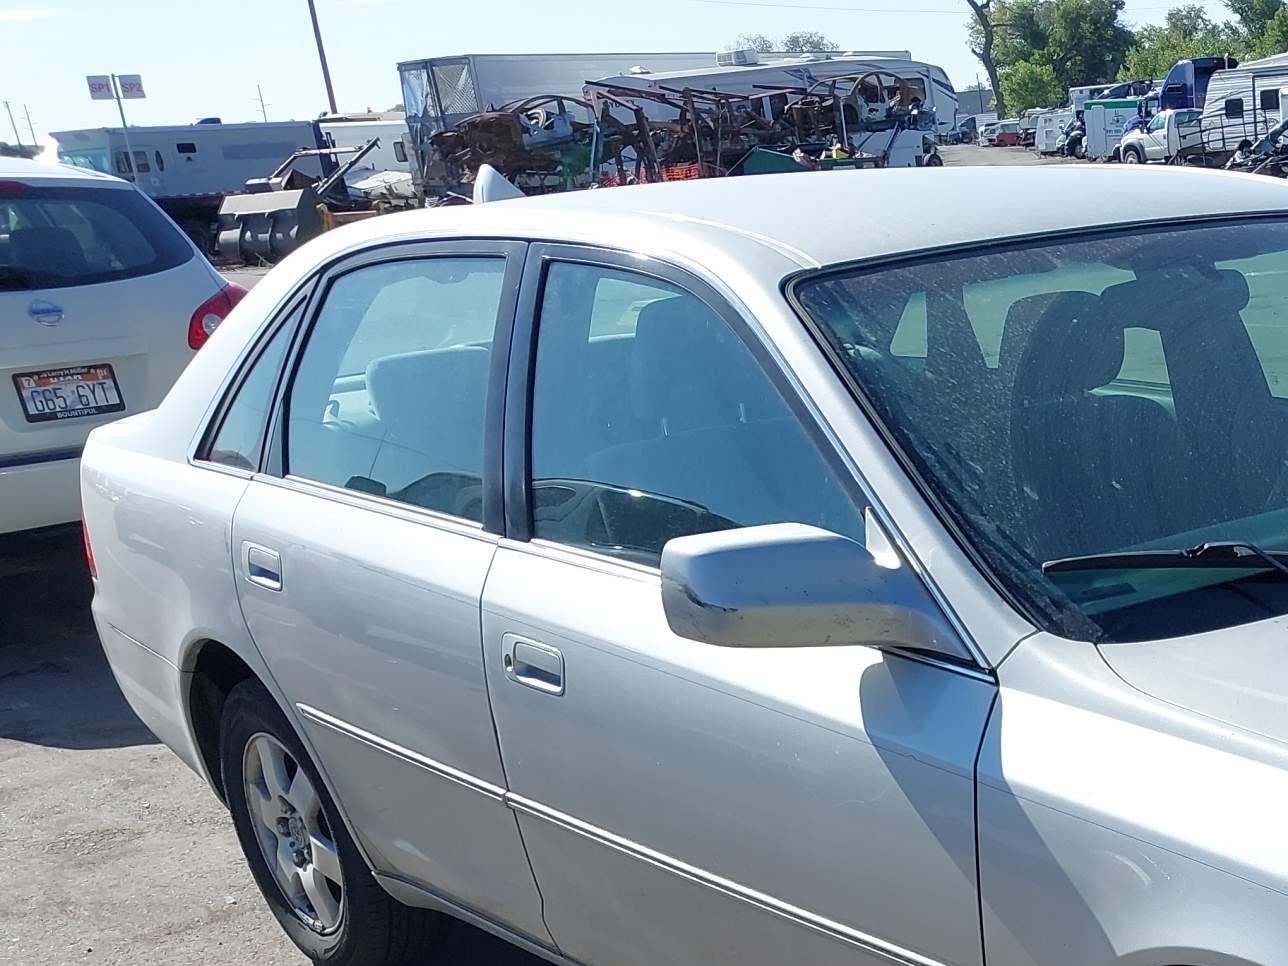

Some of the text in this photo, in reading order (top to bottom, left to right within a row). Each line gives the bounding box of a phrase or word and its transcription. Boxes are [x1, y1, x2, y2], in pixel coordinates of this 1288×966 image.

[90, 83, 111, 94] SP1
[121, 82, 143, 93] SP2
[75, 382, 110, 407] 6YT
